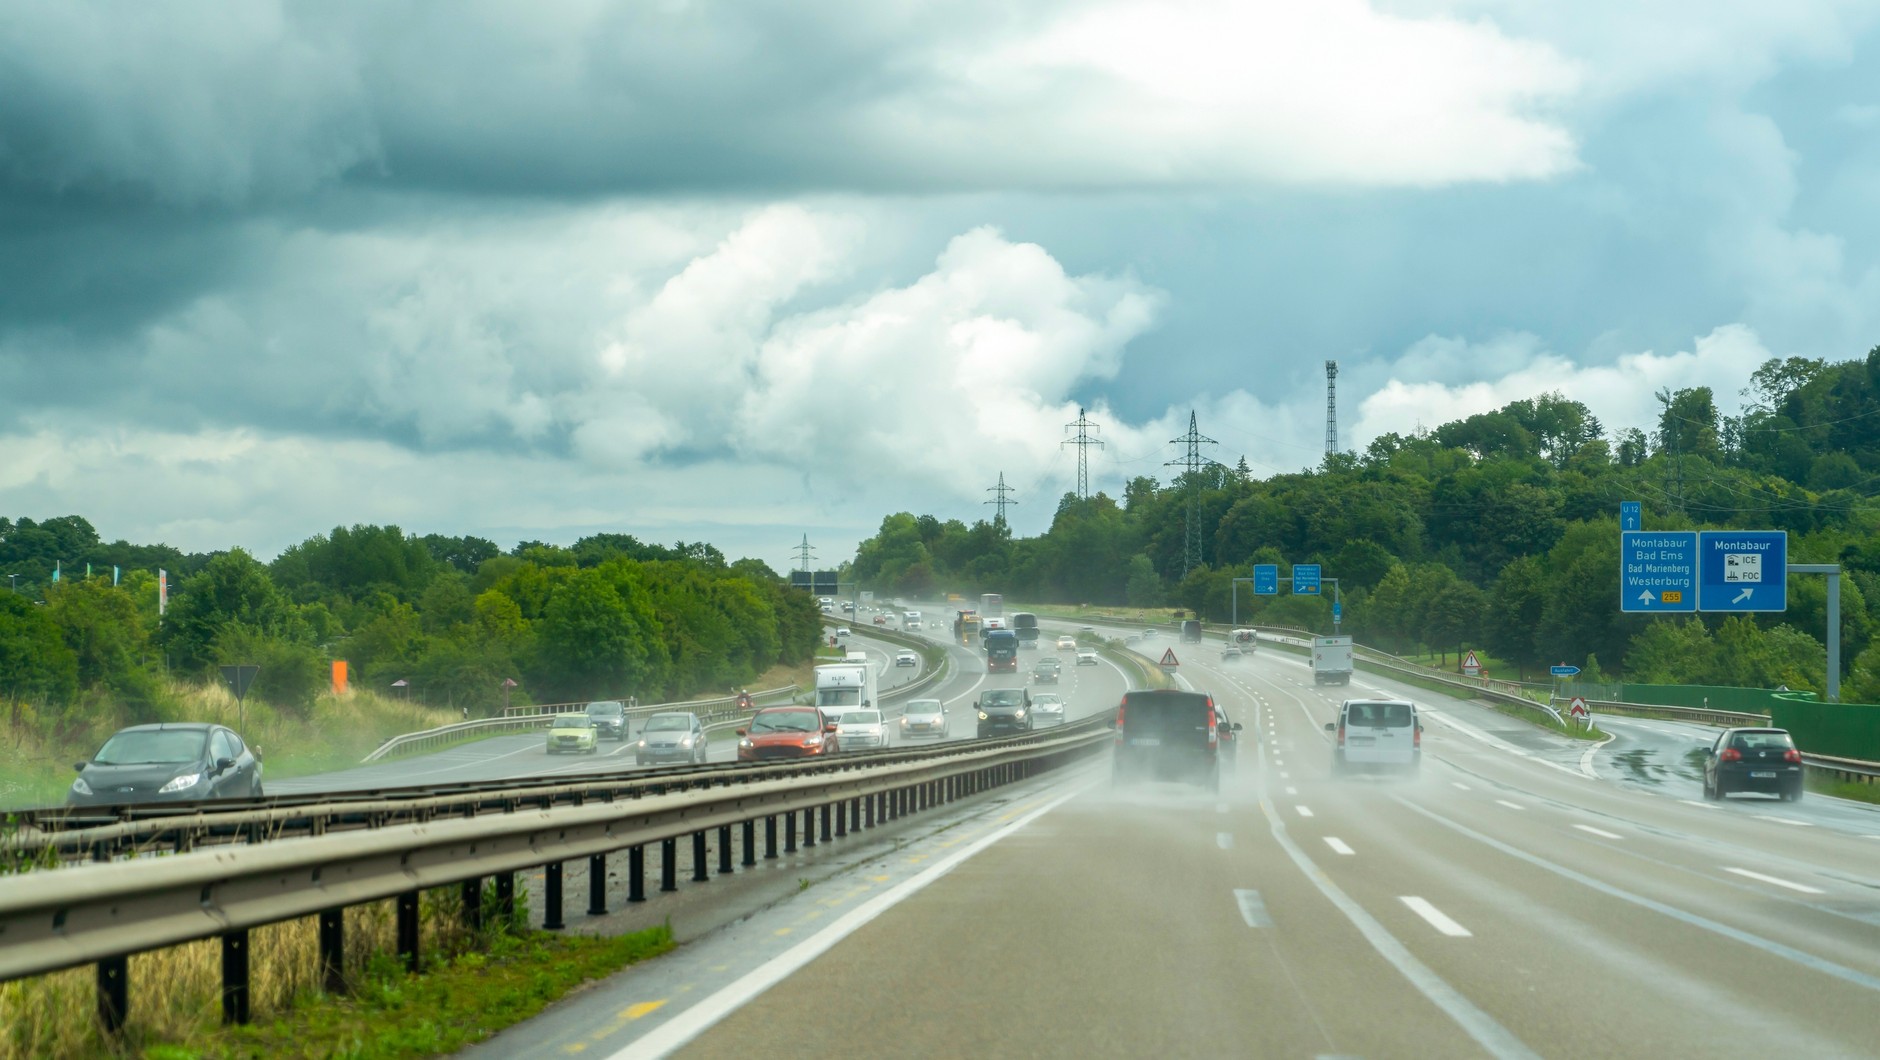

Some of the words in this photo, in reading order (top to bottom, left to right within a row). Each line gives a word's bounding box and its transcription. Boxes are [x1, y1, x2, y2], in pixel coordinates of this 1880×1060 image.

[1631, 538, 1687, 548] Montabaur
[1715, 541, 1771, 550] Montabaur
[1636, 550, 1656, 560] Bad
[1660, 550, 1683, 560] Ems
[1742, 556, 1756, 564] ICE
[1628, 563, 1643, 573] Bad
[1645, 563, 1690, 575] Marienberg
[1742, 571, 1760, 580] FOC
[1628, 576, 1690, 588] Westerburg
[1664, 593, 1680, 601] 255
